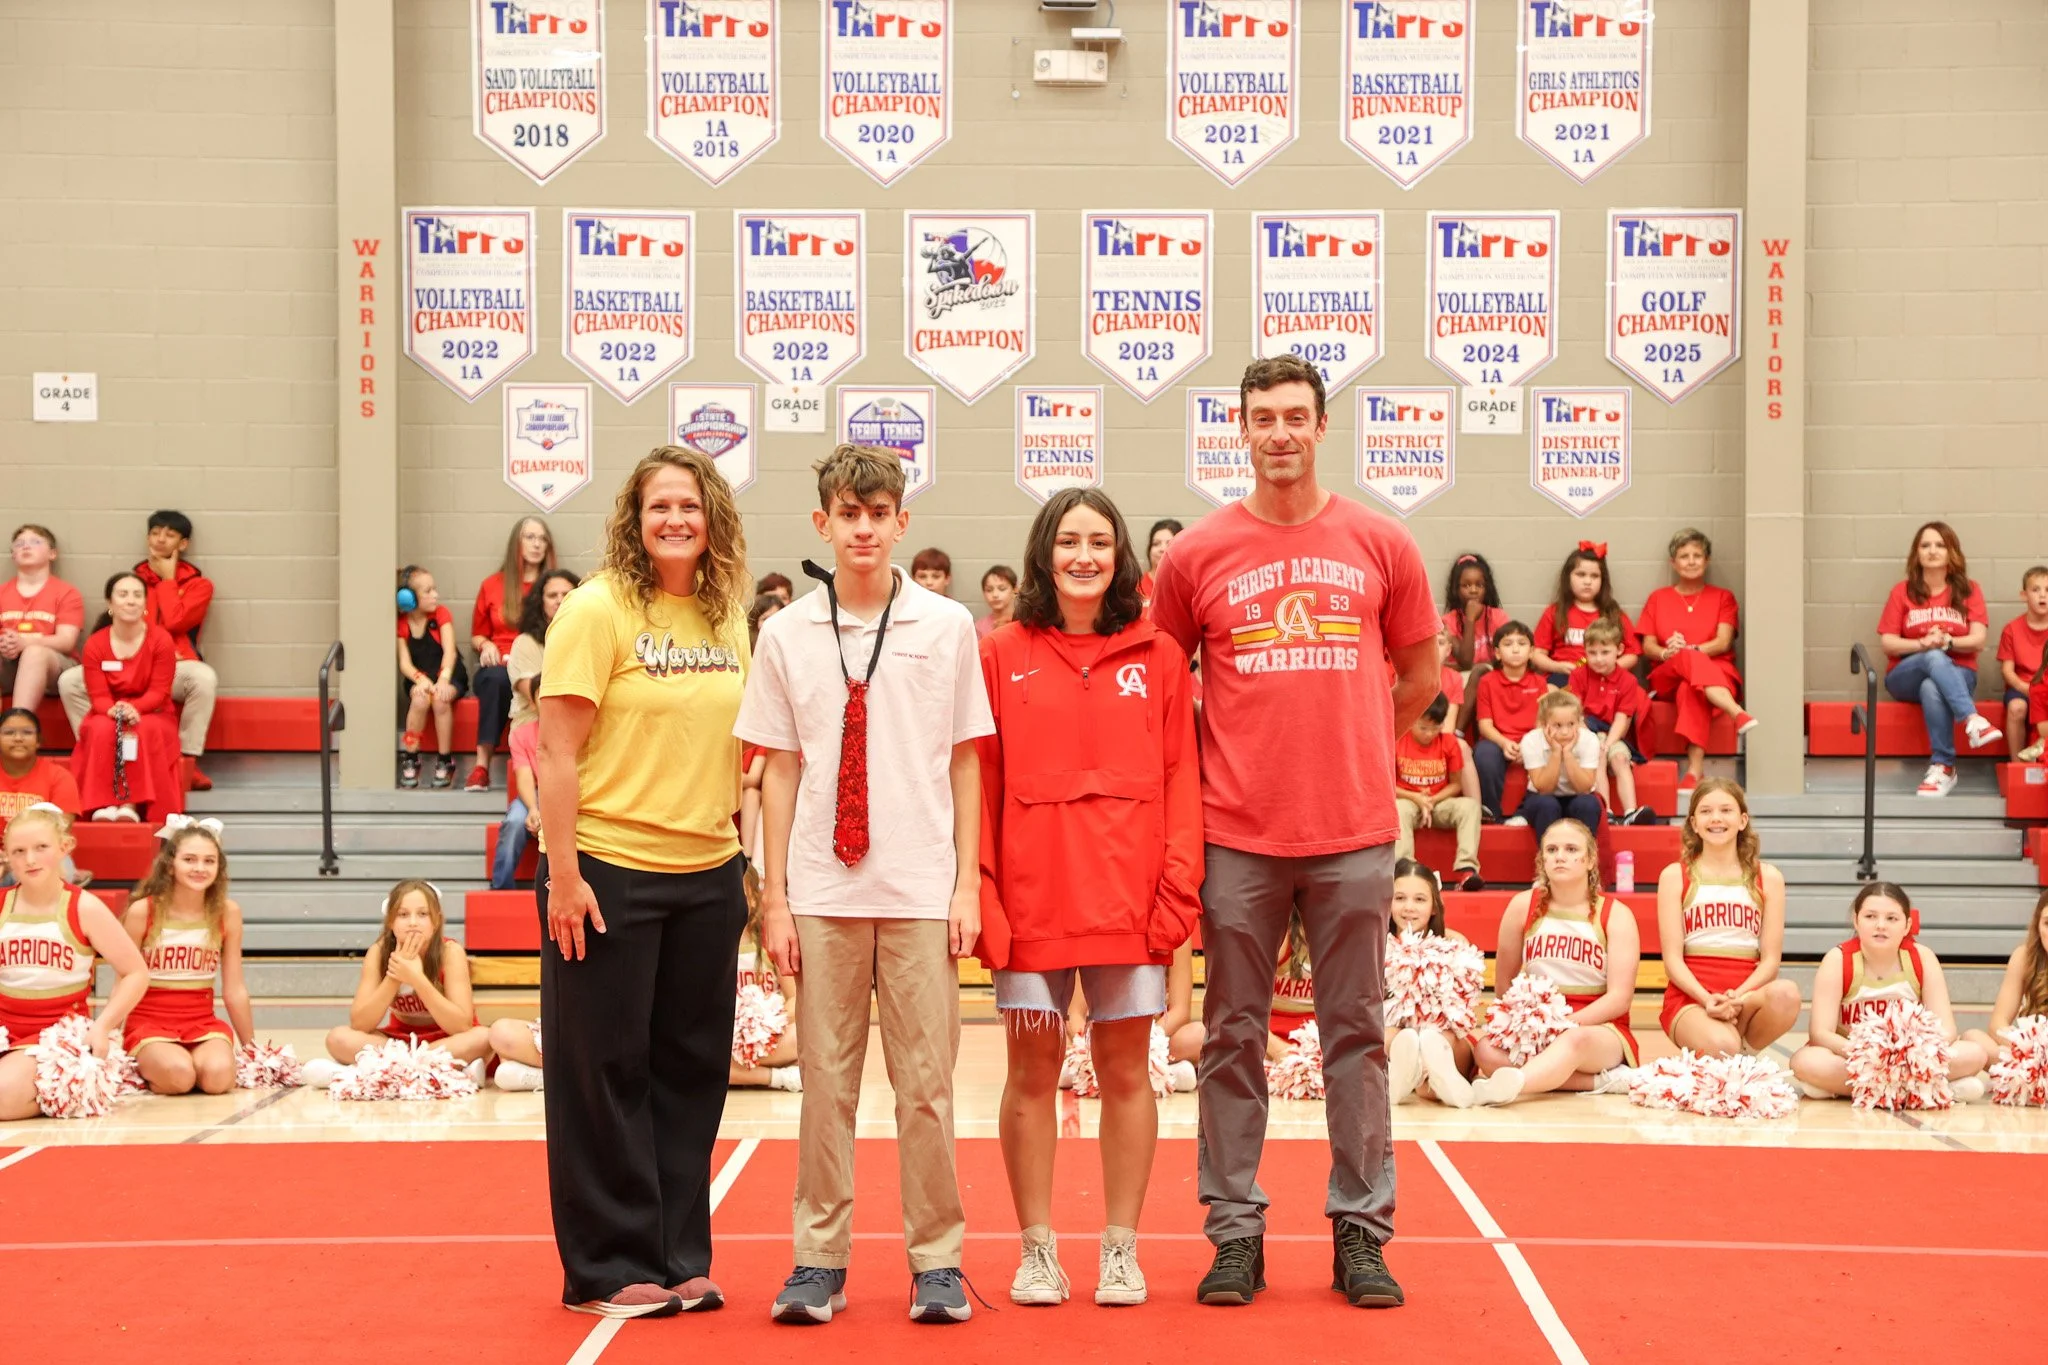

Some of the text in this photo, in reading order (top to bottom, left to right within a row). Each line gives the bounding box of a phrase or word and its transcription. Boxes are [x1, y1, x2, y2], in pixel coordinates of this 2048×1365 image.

[485, 69, 595, 90] SAND VOLLEYBALL
[661, 72, 769, 94] VOLLEYBALL
[832, 72, 941, 94] VOLLEYBALL
[1179, 72, 1288, 94] VOLLEYBALL
[1352, 73, 1463, 95] BASKETBALL
[1529, 71, 1640, 90] GIRLS ATHLETICS
[486, 92, 596, 114] CHAMPIONS
[661, 95, 769, 118] CHAMPION
[832, 95, 941, 119] CHAMPION
[1179, 95, 1288, 118] CHAMPION
[1352, 95, 1462, 120] RUNNERUP
[1529, 91, 1639, 113] CHAMPION
[514, 124, 569, 146] 2018
[706, 120, 729, 137] 1A
[858, 124, 914, 144] 2020
[1205, 125, 1259, 144] 2021
[1379, 125, 1434, 144] 2021
[1555, 124, 1611, 140] 2021
[693, 141, 739, 157] 2018
[877, 150, 897, 162] 1A
[1223, 150, 1245, 164] 1A
[1397, 151, 1418, 165] 1A
[1573, 149, 1595, 163] 1A
[415, 288, 525, 310] VOLLEYBALL
[574, 290, 683, 312] BASKETBALL
[746, 290, 855, 311] BASKETBALL
[924, 274, 1019, 319] Spikedown
[1093, 290, 1201, 312] TENNIS
[1263, 291, 1373, 313] VOLLEYBALL
[1437, 292, 1547, 313] VOLLEYBALL
[1642, 291, 1706, 313] GOLF
[352, 238, 380, 418] WARRIORS
[415, 311, 525, 334] CHAMPION
[574, 313, 683, 337] CHAMPIONS
[746, 313, 855, 336] CHAMPIONS
[1093, 313, 1200, 336] CHAMPION
[1263, 314, 1373, 337] CHAMPION
[1437, 315, 1547, 338] CHAMPION
[1618, 314, 1730, 337] CHAMPION
[1762, 239, 1790, 419] WARRIORS
[442, 340, 498, 359] 2022
[915, 329, 1024, 352] CHAMPION
[600, 342, 656, 361] 2022
[773, 342, 829, 361] 2022
[1119, 342, 1175, 360] 2023
[1290, 343, 1346, 361] 2023
[1463, 344, 1520, 362] 2024
[1644, 343, 1702, 362] 2025
[461, 365, 483, 379] 1A
[618, 368, 639, 381] 1A
[791, 366, 813, 381] 1A
[1137, 366, 1158, 380] 1A
[1320, 368, 1331, 382] A
[1481, 369, 1503, 383] 1A
[1662, 368, 1685, 383] 1A
[40, 387, 90, 399] GRADE
[61, 401, 70, 411] 4
[772, 399, 819, 410] GRADE
[1468, 401, 1517, 412] GRADE
[791, 412, 799, 423] 3
[1488, 414, 1496, 425] 2
[850, 423, 922, 440] TEAM TENNIS
[1024, 434, 1094, 448] DISTRICT
[1366, 435, 1444, 448] DISTRICT
[1542, 436, 1620, 449] DISTRICT
[1024, 449, 1094, 463] TENNIS
[1197, 452, 1230, 465] TRACK
[1235, 452, 1241, 465] &
[1366, 450, 1444, 463] TENNIS
[1542, 451, 1620, 465] TENNIS
[511, 460, 584, 476] CHAMPION
[1024, 465, 1093, 479] CHAMPION
[1197, 467, 1233, 480] THIRD
[1366, 466, 1443, 480] CHAMPION
[1542, 466, 1620, 481] RUNNER-UP
[1223, 487, 1247, 497] 2025
[1392, 485, 1417, 495] 2025
[1569, 486, 1593, 496] 2025
[1227, 556, 1365, 607] CHRIST ACADEMY
[1244, 603, 1262, 621] 19
[1330, 594, 1350, 611] 53
[1234, 646, 1359, 676] WARRIORS
[1684, 902, 1760, 936] WARRIORS
[0, 939, 73, 971] ARRIORS
[1526, 935, 1604, 971] WARRIORS
